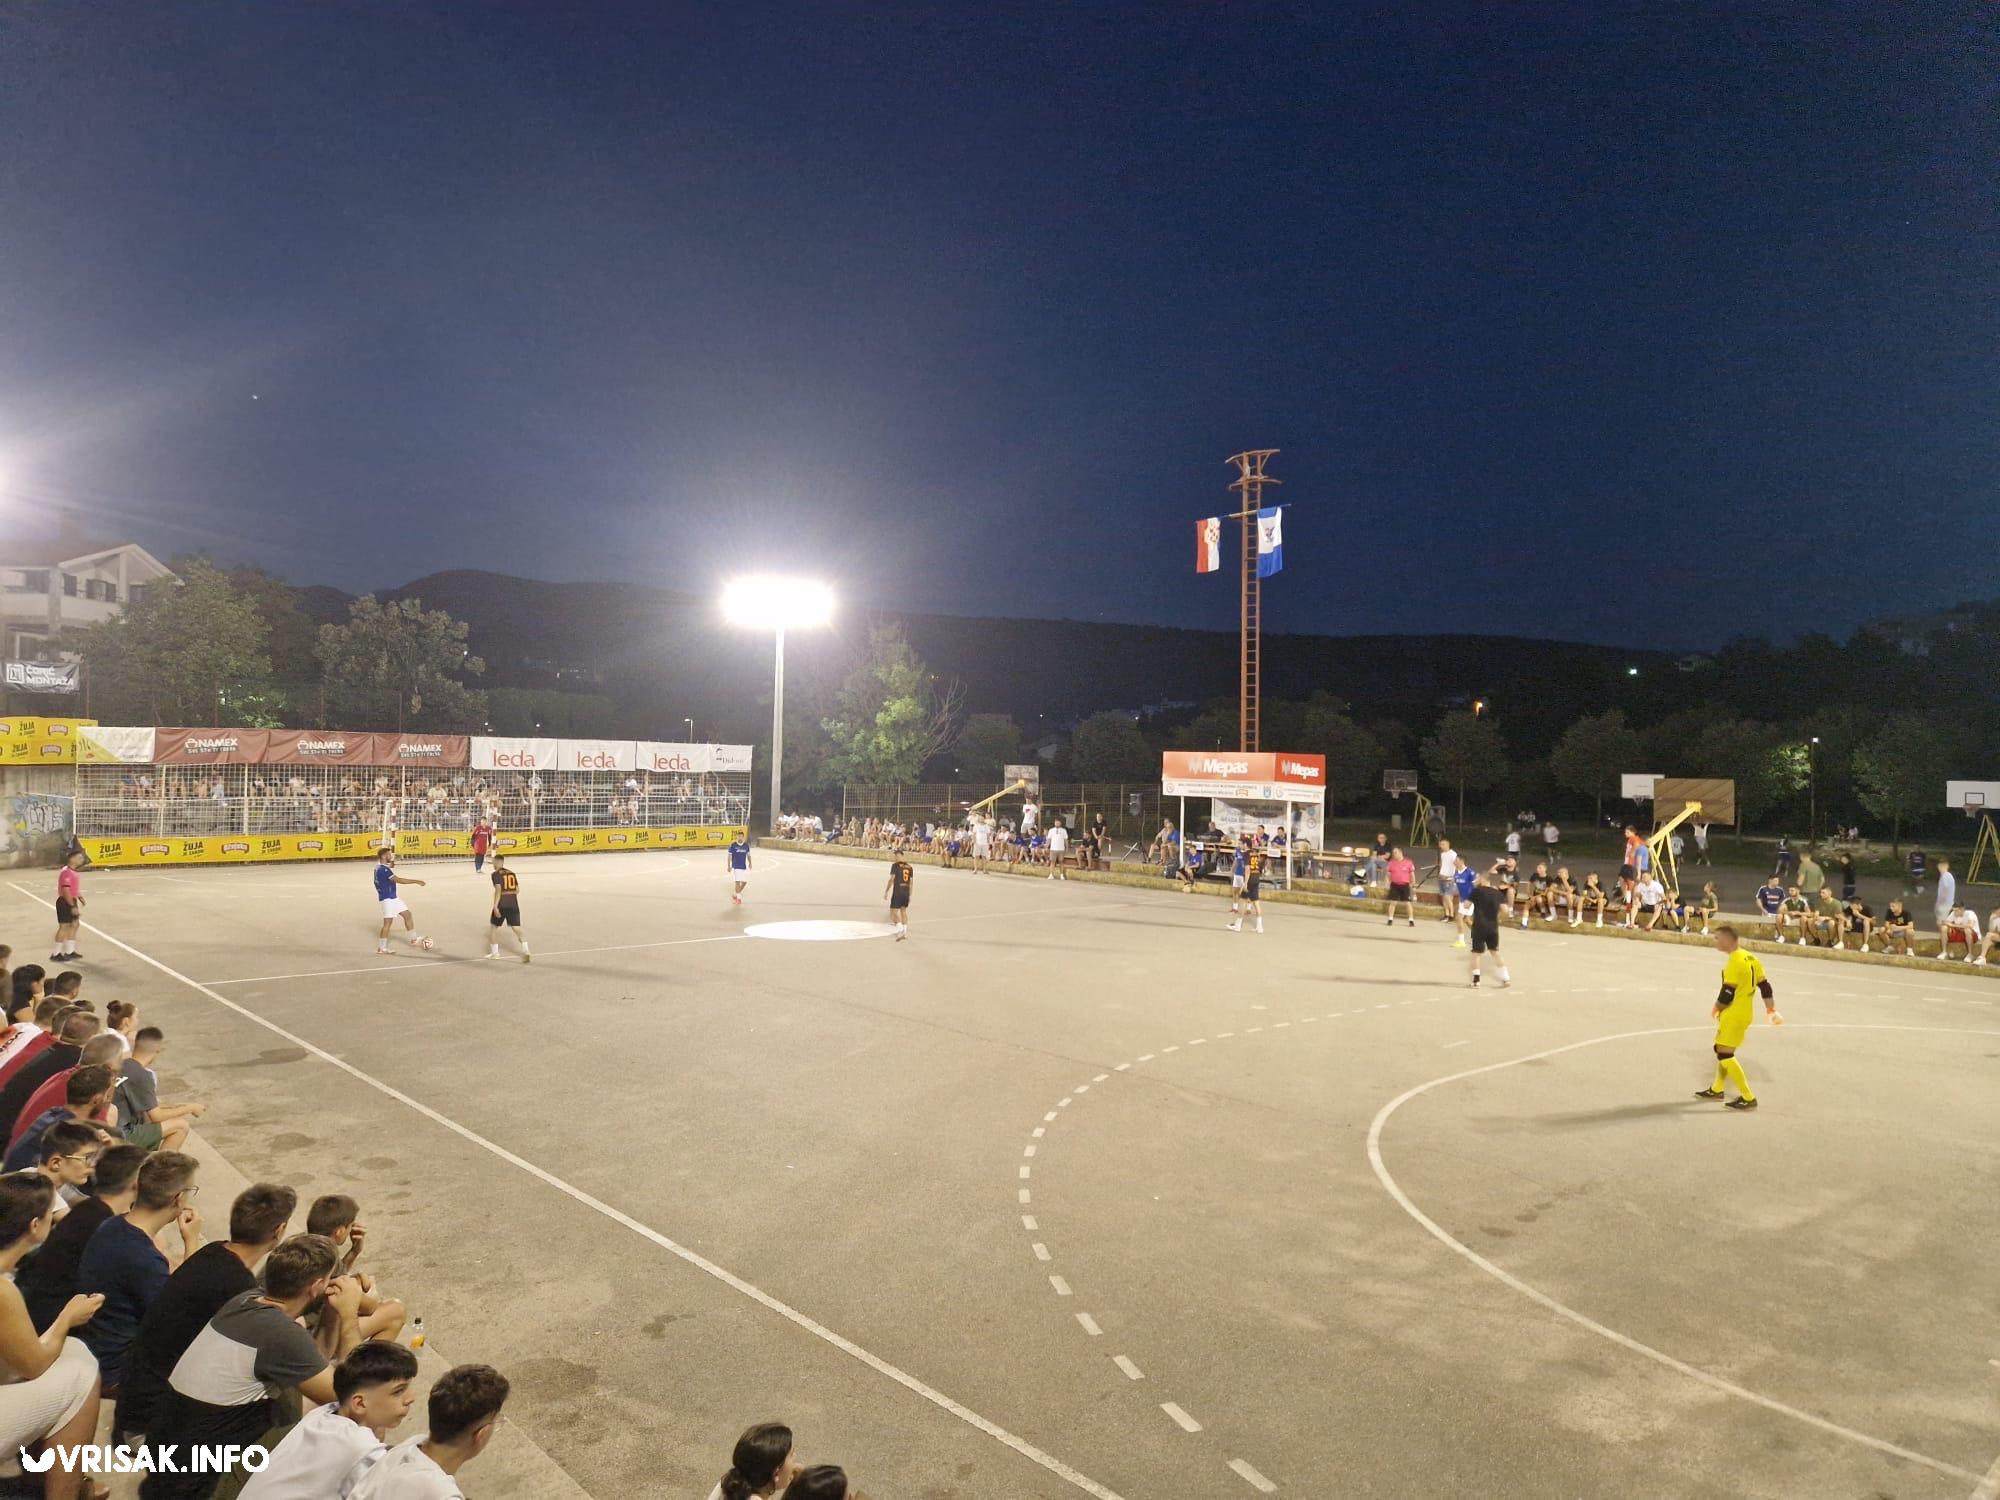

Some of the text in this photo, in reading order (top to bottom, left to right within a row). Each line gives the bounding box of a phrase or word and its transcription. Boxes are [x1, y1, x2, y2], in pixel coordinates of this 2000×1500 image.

[198, 738, 238, 747] NAMEX
[309, 740, 345, 749] NAMEX
[410, 743, 442, 752] NAMEX
[492, 749, 536, 767] leda
[577, 751, 617, 768] leda
[653, 753, 691, 771] leda
[1203, 758, 1249, 778] Mepas
[1290, 762, 1320, 779] Mepas
[183, 841, 204, 851] ŽUJA
[262, 839, 281, 849] ŽUJA
[334, 837, 352, 847] ŽUJA
[99, 843, 122, 854] ŽUJA
[902, 869, 909, 882] 6
[503, 875, 516, 889] 10
